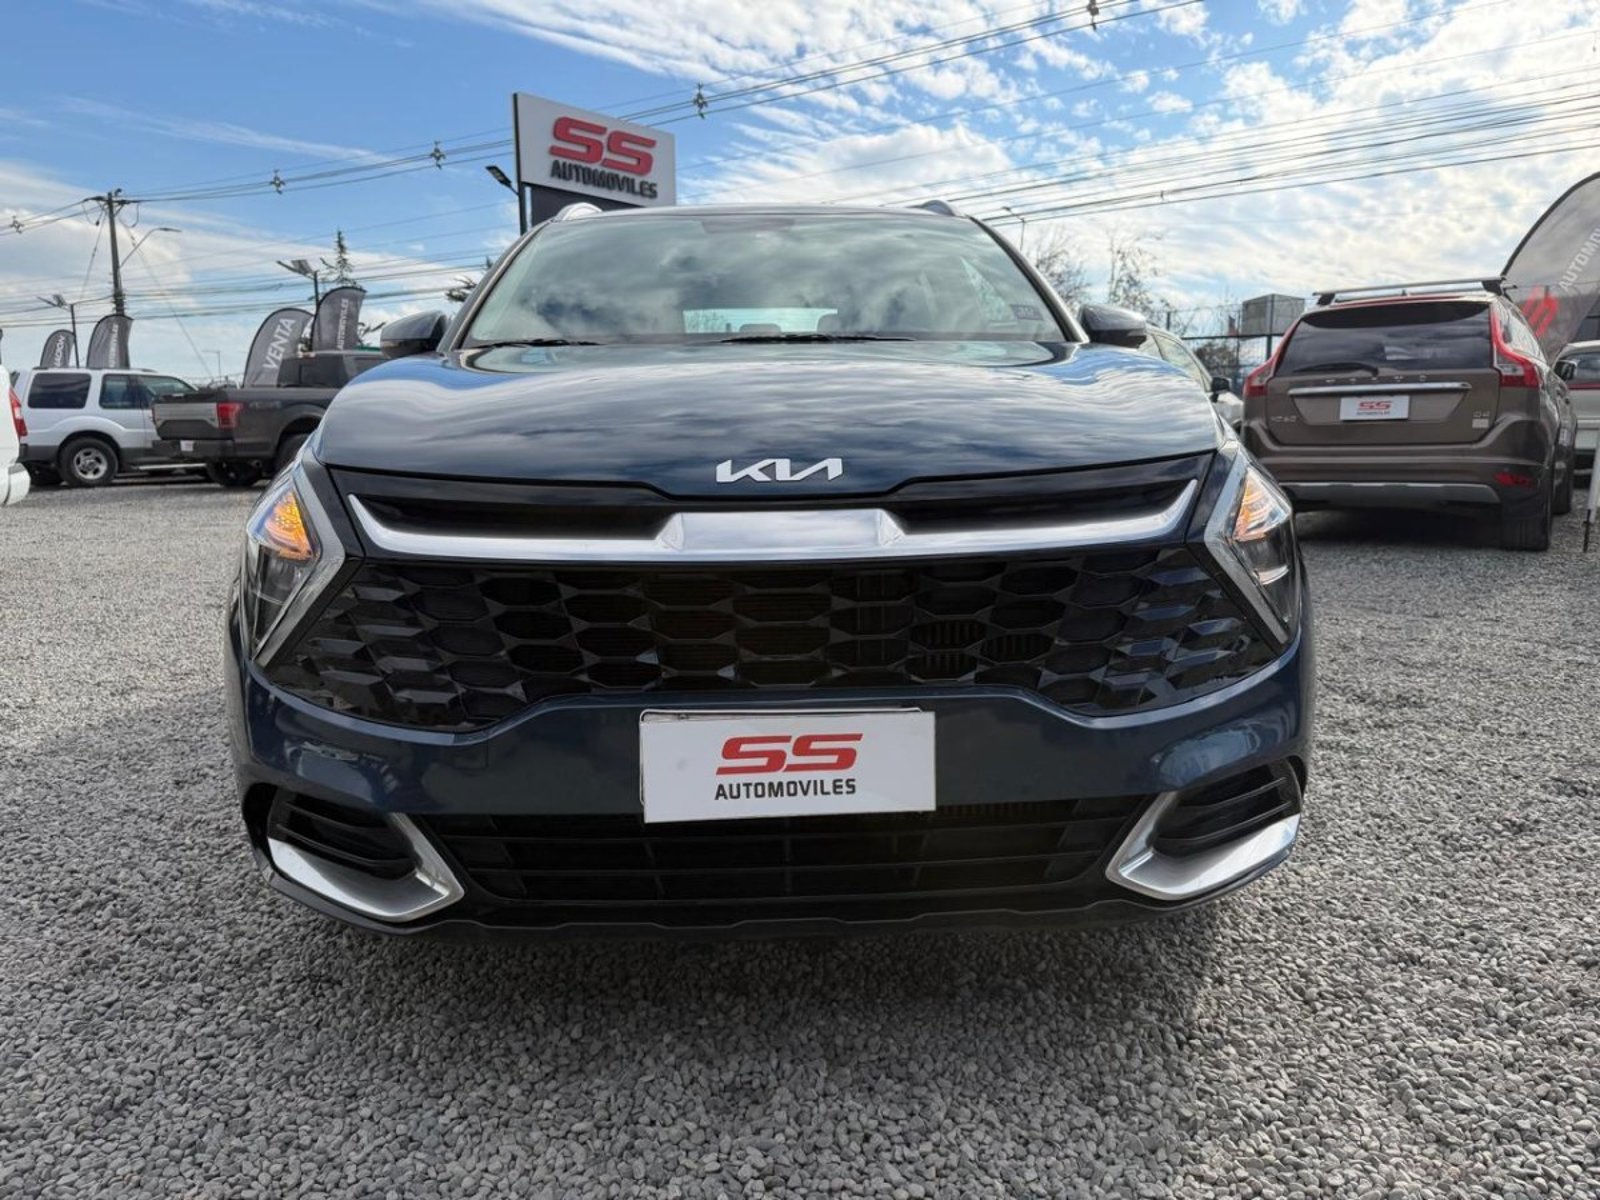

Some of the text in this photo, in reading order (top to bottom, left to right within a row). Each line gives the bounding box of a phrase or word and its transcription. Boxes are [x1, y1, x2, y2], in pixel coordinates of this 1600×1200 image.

[548, 116, 657, 176] SS
[550, 159, 658, 199] AUTOMOVILES
[262, 318, 296, 369] VENTA
[1356, 400, 1393, 411] SS
[715, 457, 844, 483] KIA
[715, 733, 864, 776] SS
[714, 778, 857, 801] AUTOMOVILES
